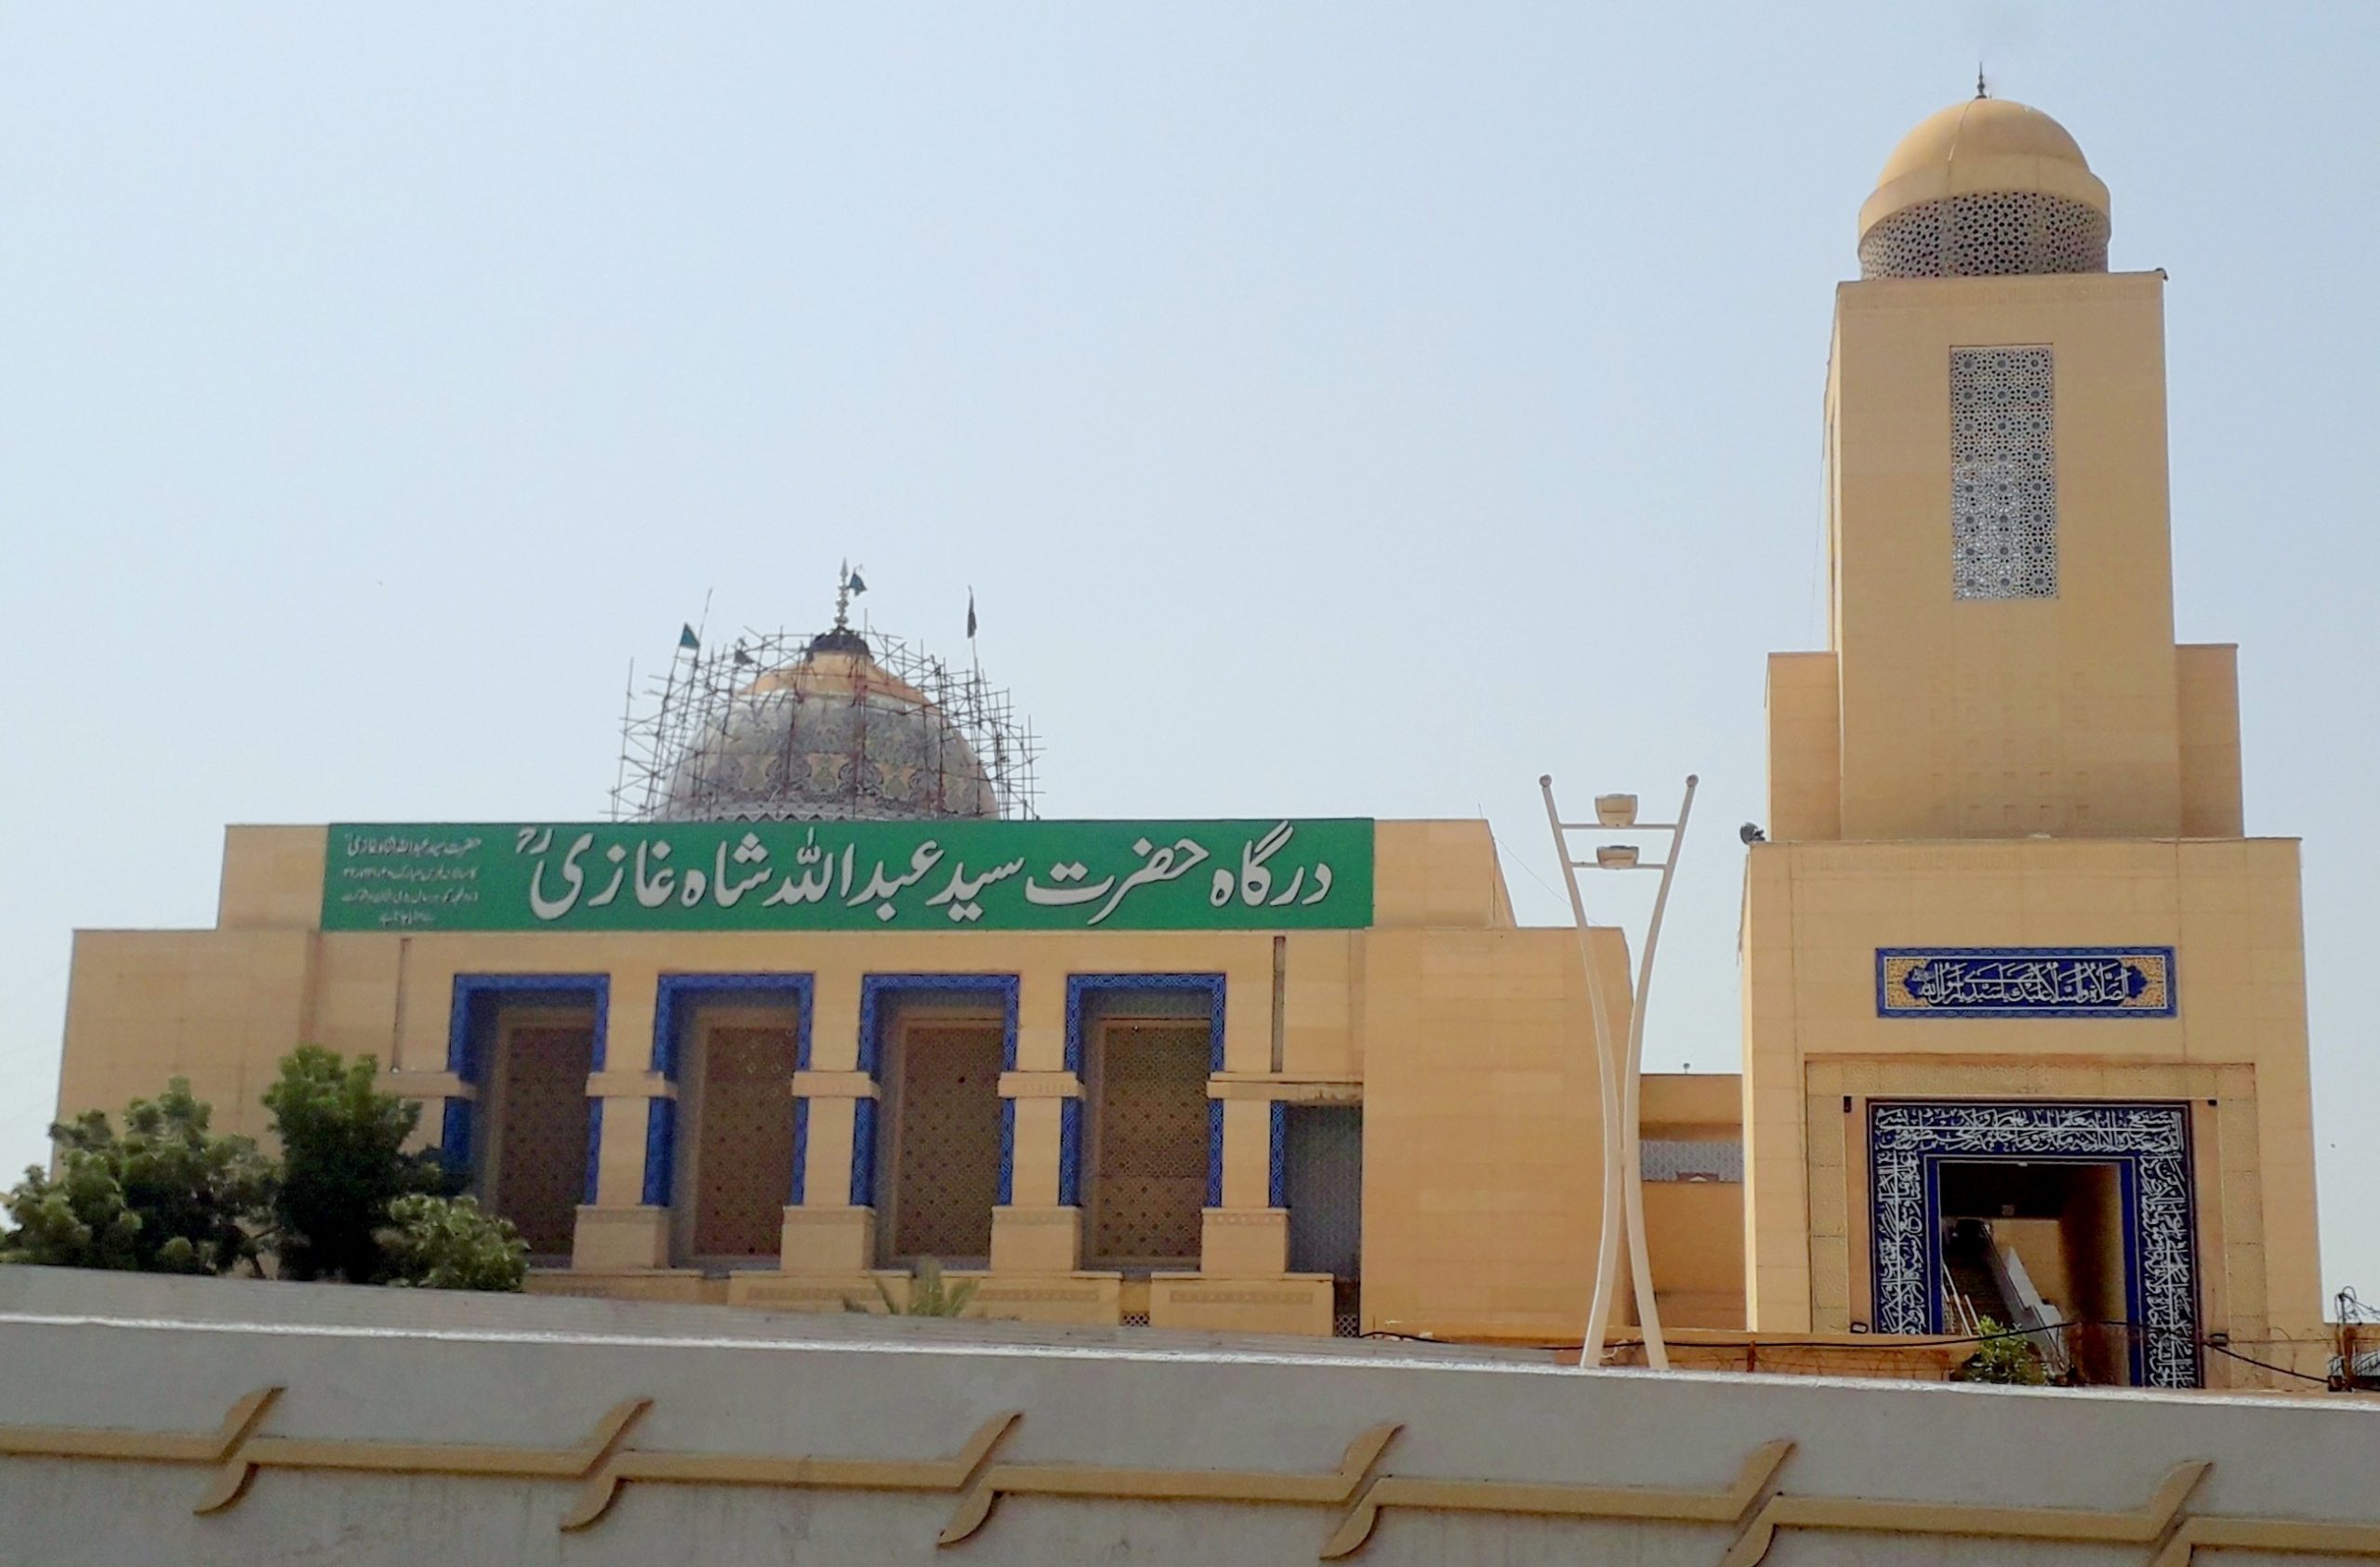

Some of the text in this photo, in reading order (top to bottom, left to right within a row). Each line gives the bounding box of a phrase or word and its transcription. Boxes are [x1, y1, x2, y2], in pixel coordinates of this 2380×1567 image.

[529, 833, 676, 920] غازی
[681, 832, 772, 908] شاہ
[925, 857, 1025, 922] سید
[1024, 837, 1210, 926] حضرت
[1210, 821, 1333, 907] درگاہ
